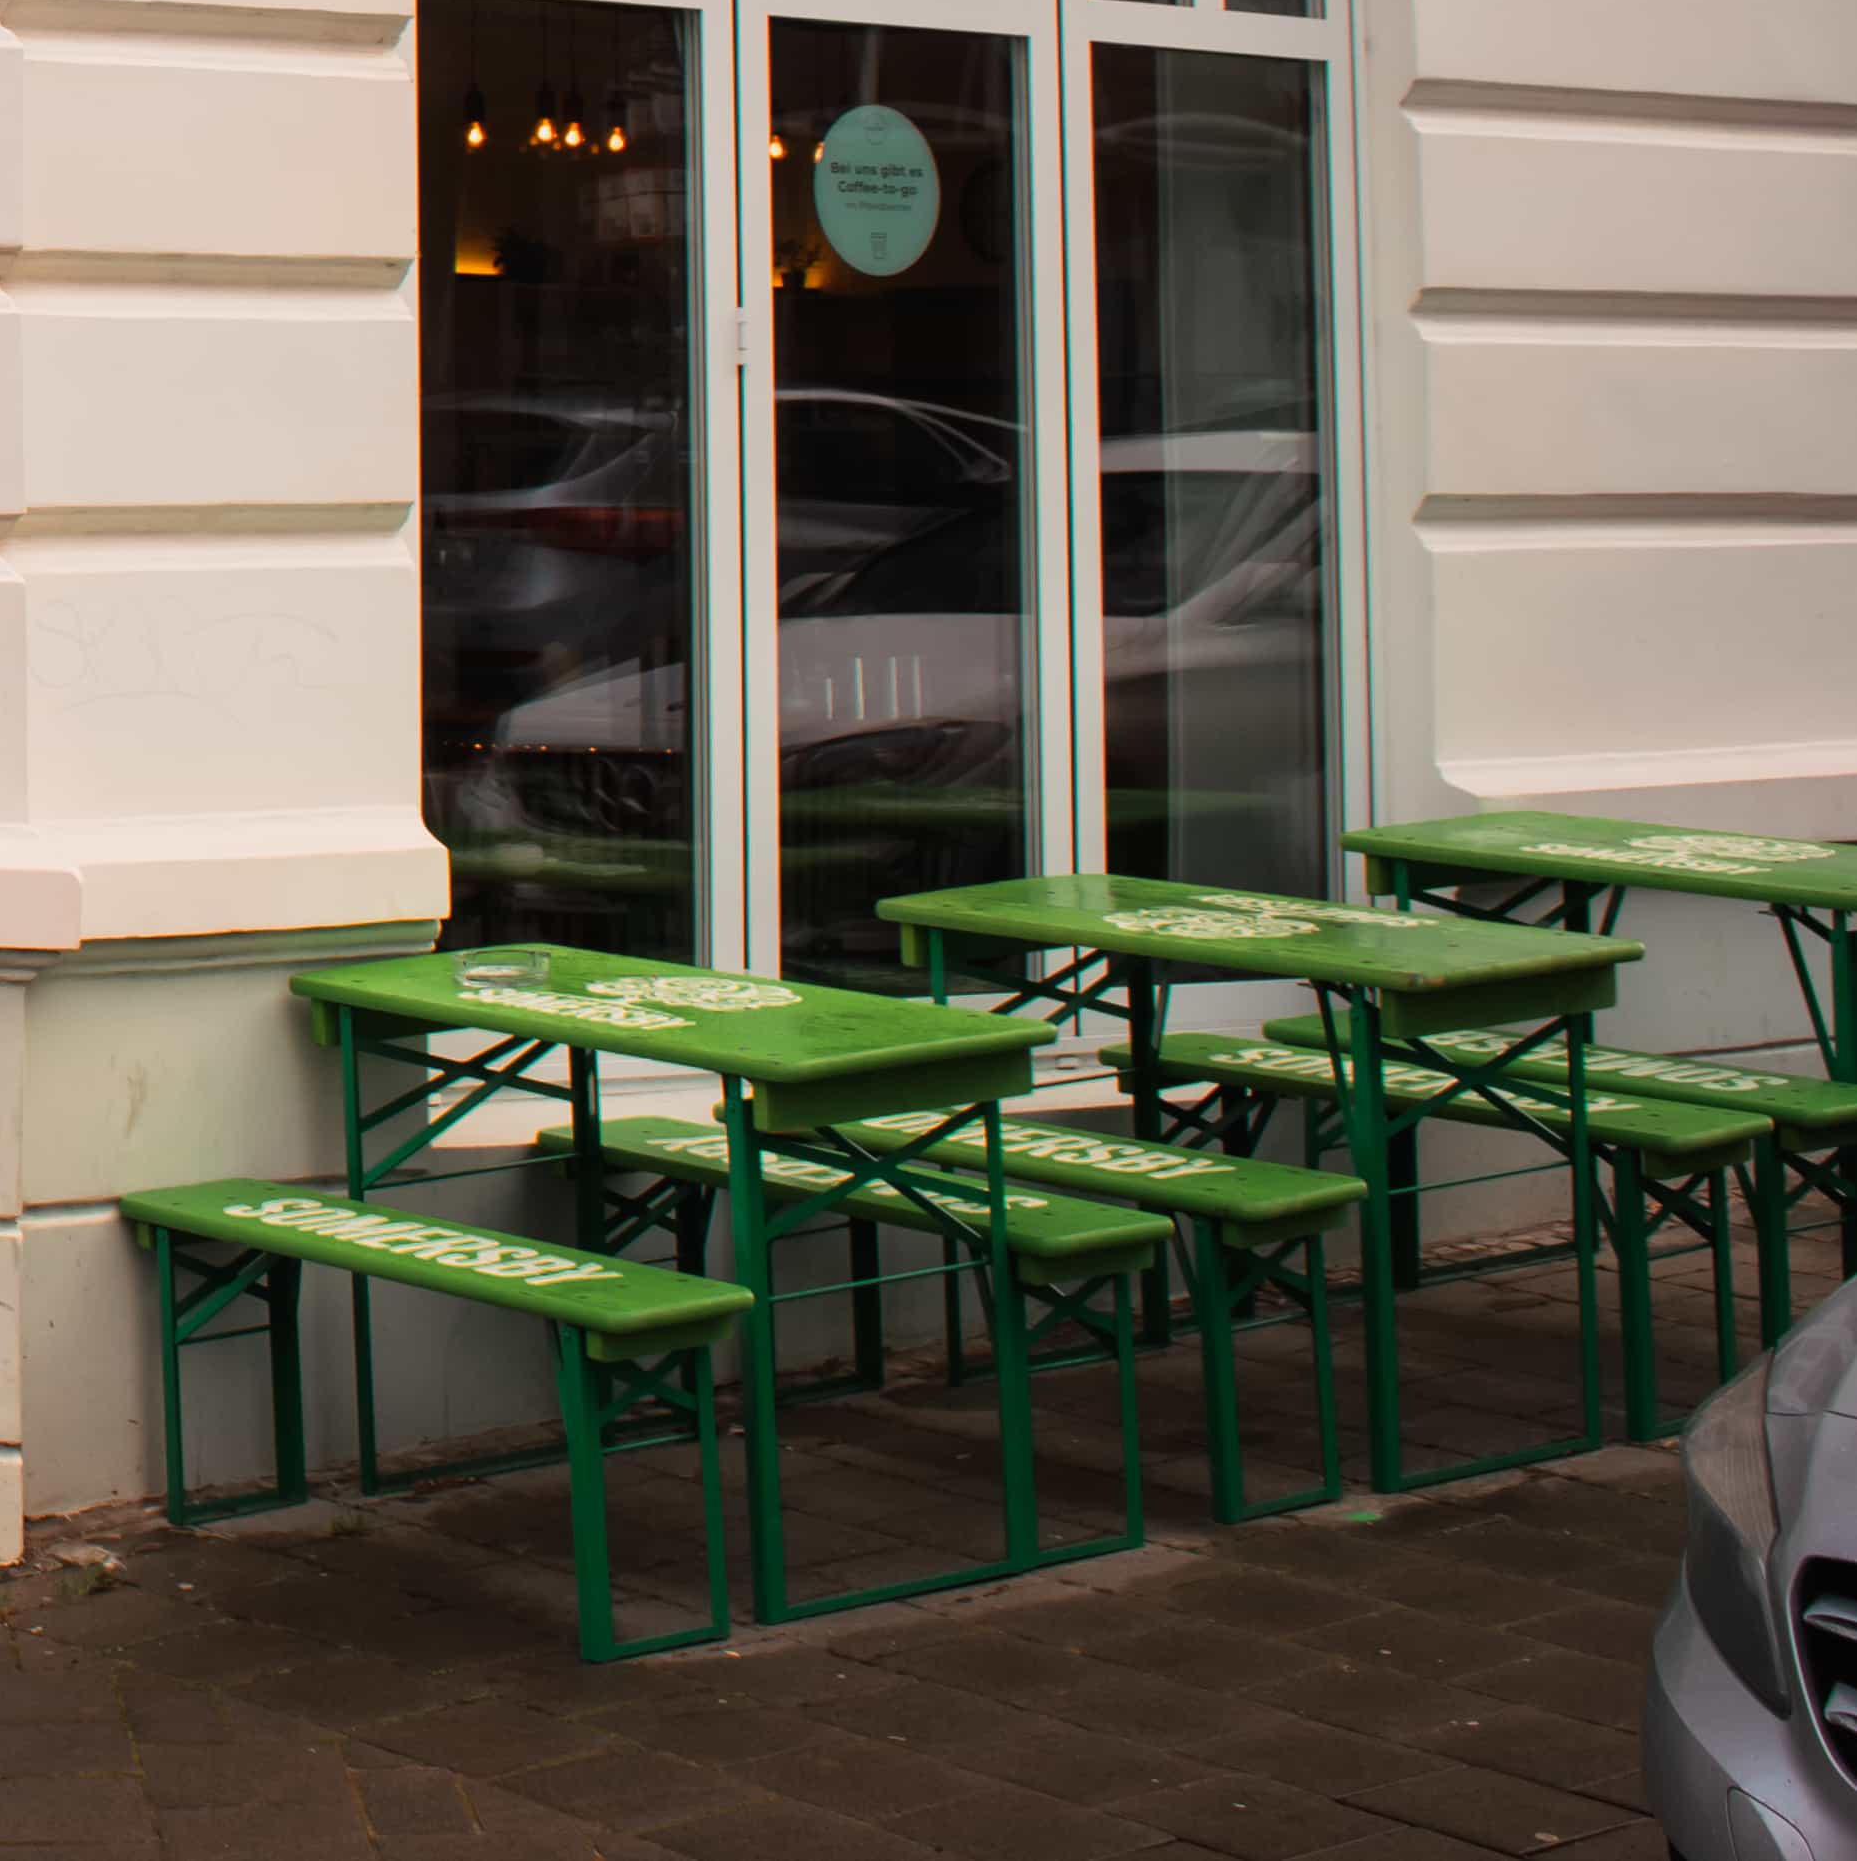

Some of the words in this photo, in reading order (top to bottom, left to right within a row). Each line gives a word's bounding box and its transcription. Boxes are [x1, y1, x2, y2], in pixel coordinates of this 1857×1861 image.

[830, 161, 852, 174] Bei
[854, 165, 877, 176] uns
[880, 164, 907, 179] gibt
[909, 168, 924, 178] es
[222, 1196, 624, 1287] SOMERSBY
